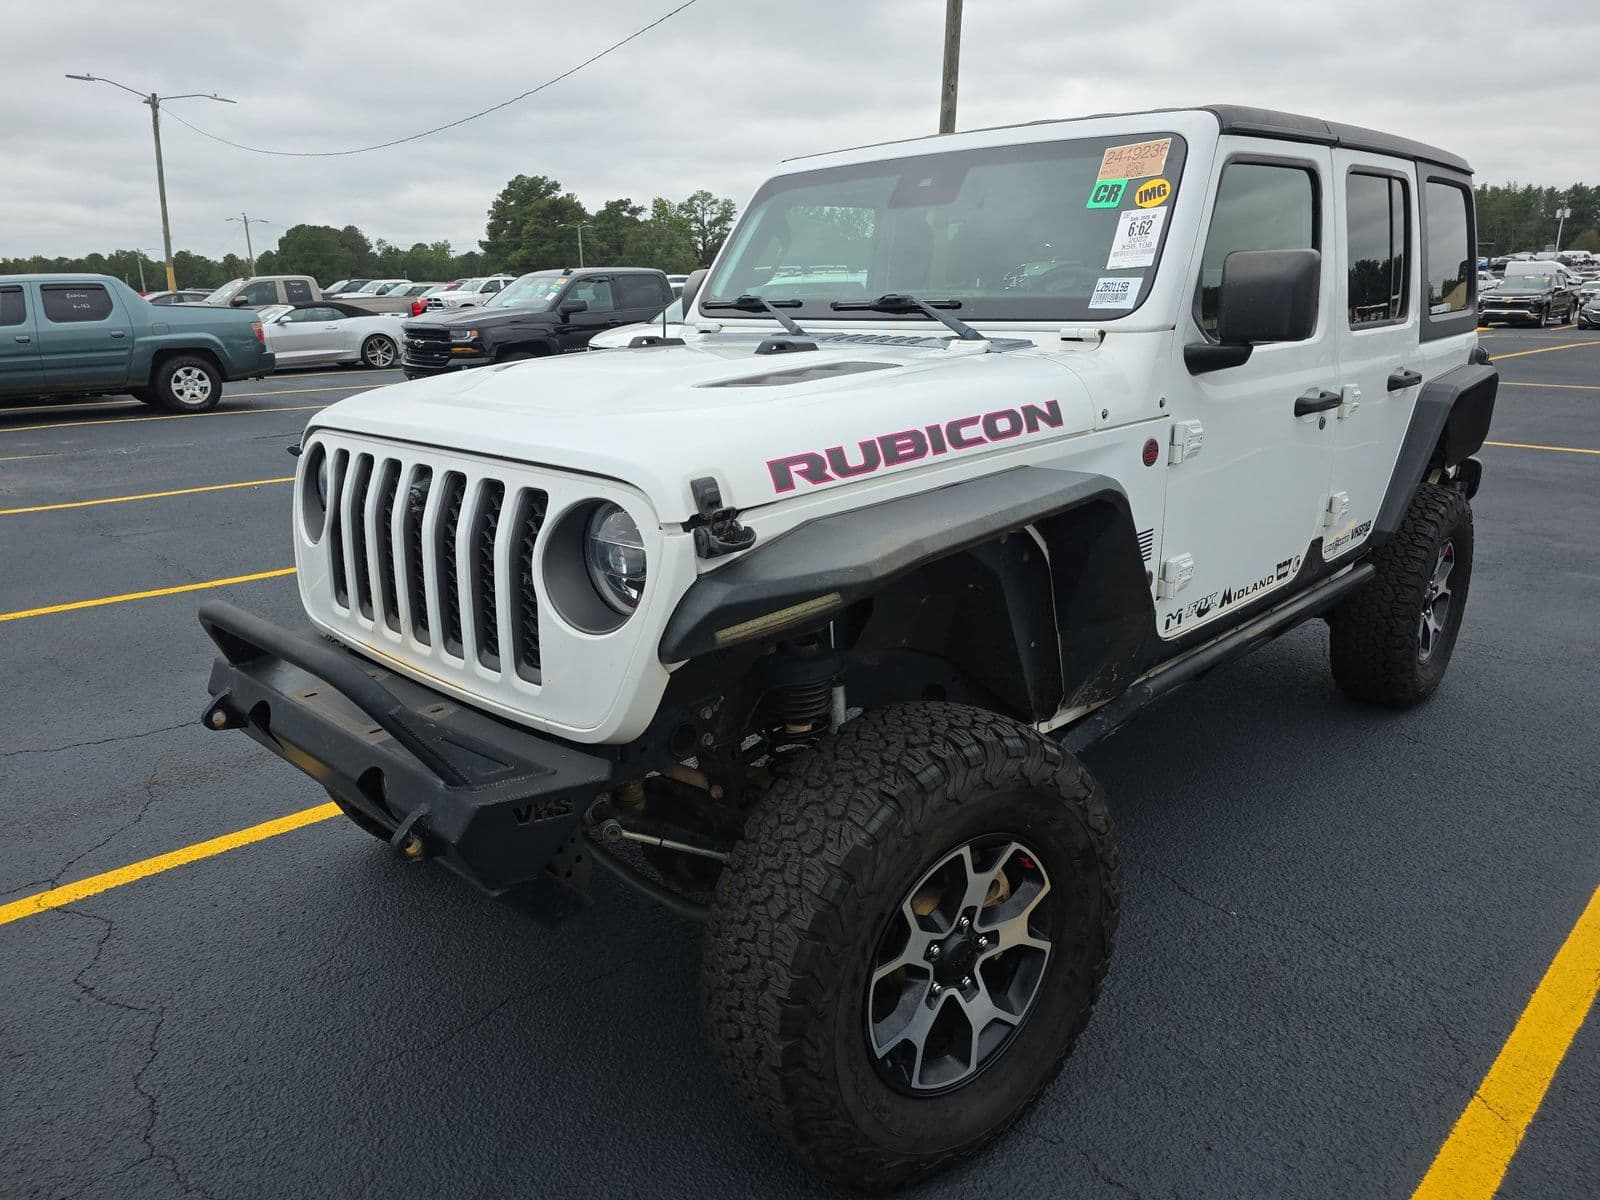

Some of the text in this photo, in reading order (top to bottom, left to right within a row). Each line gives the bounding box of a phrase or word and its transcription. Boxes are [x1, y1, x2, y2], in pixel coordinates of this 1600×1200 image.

[1092, 184, 1121, 203] CR
[1139, 184, 1167, 204] IMG
[1128, 220, 1153, 237] 6:62
[766, 399, 1063, 493] RUBICON
[1185, 592, 1218, 618] FOX
[512, 799, 573, 826] VKS
